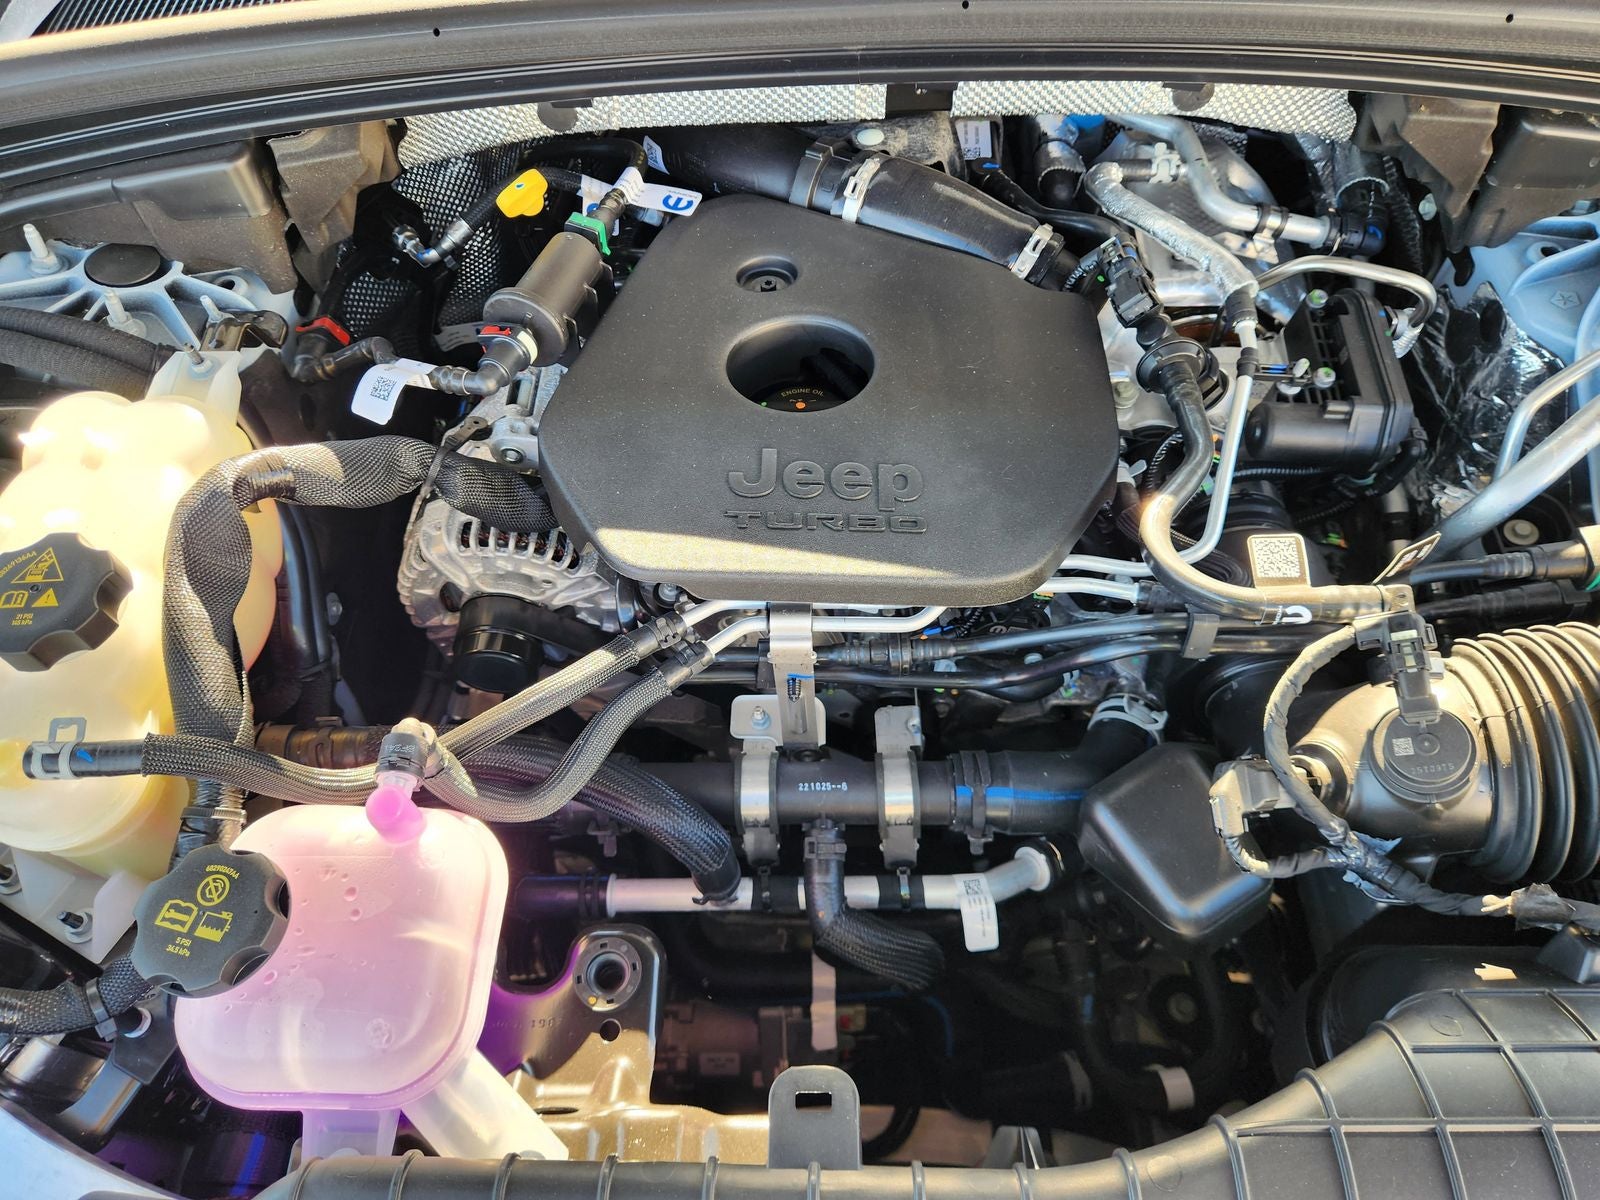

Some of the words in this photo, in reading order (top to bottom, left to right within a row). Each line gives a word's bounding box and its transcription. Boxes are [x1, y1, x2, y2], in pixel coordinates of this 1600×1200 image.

[781, 388, 810, 397] ENGINE
[812, 389, 825, 397] OIL
[727, 448, 924, 511] Jeep
[723, 510, 928, 533] TURBO
[180, 937, 192, 947] PSI
[179, 946, 190, 957] kPa
